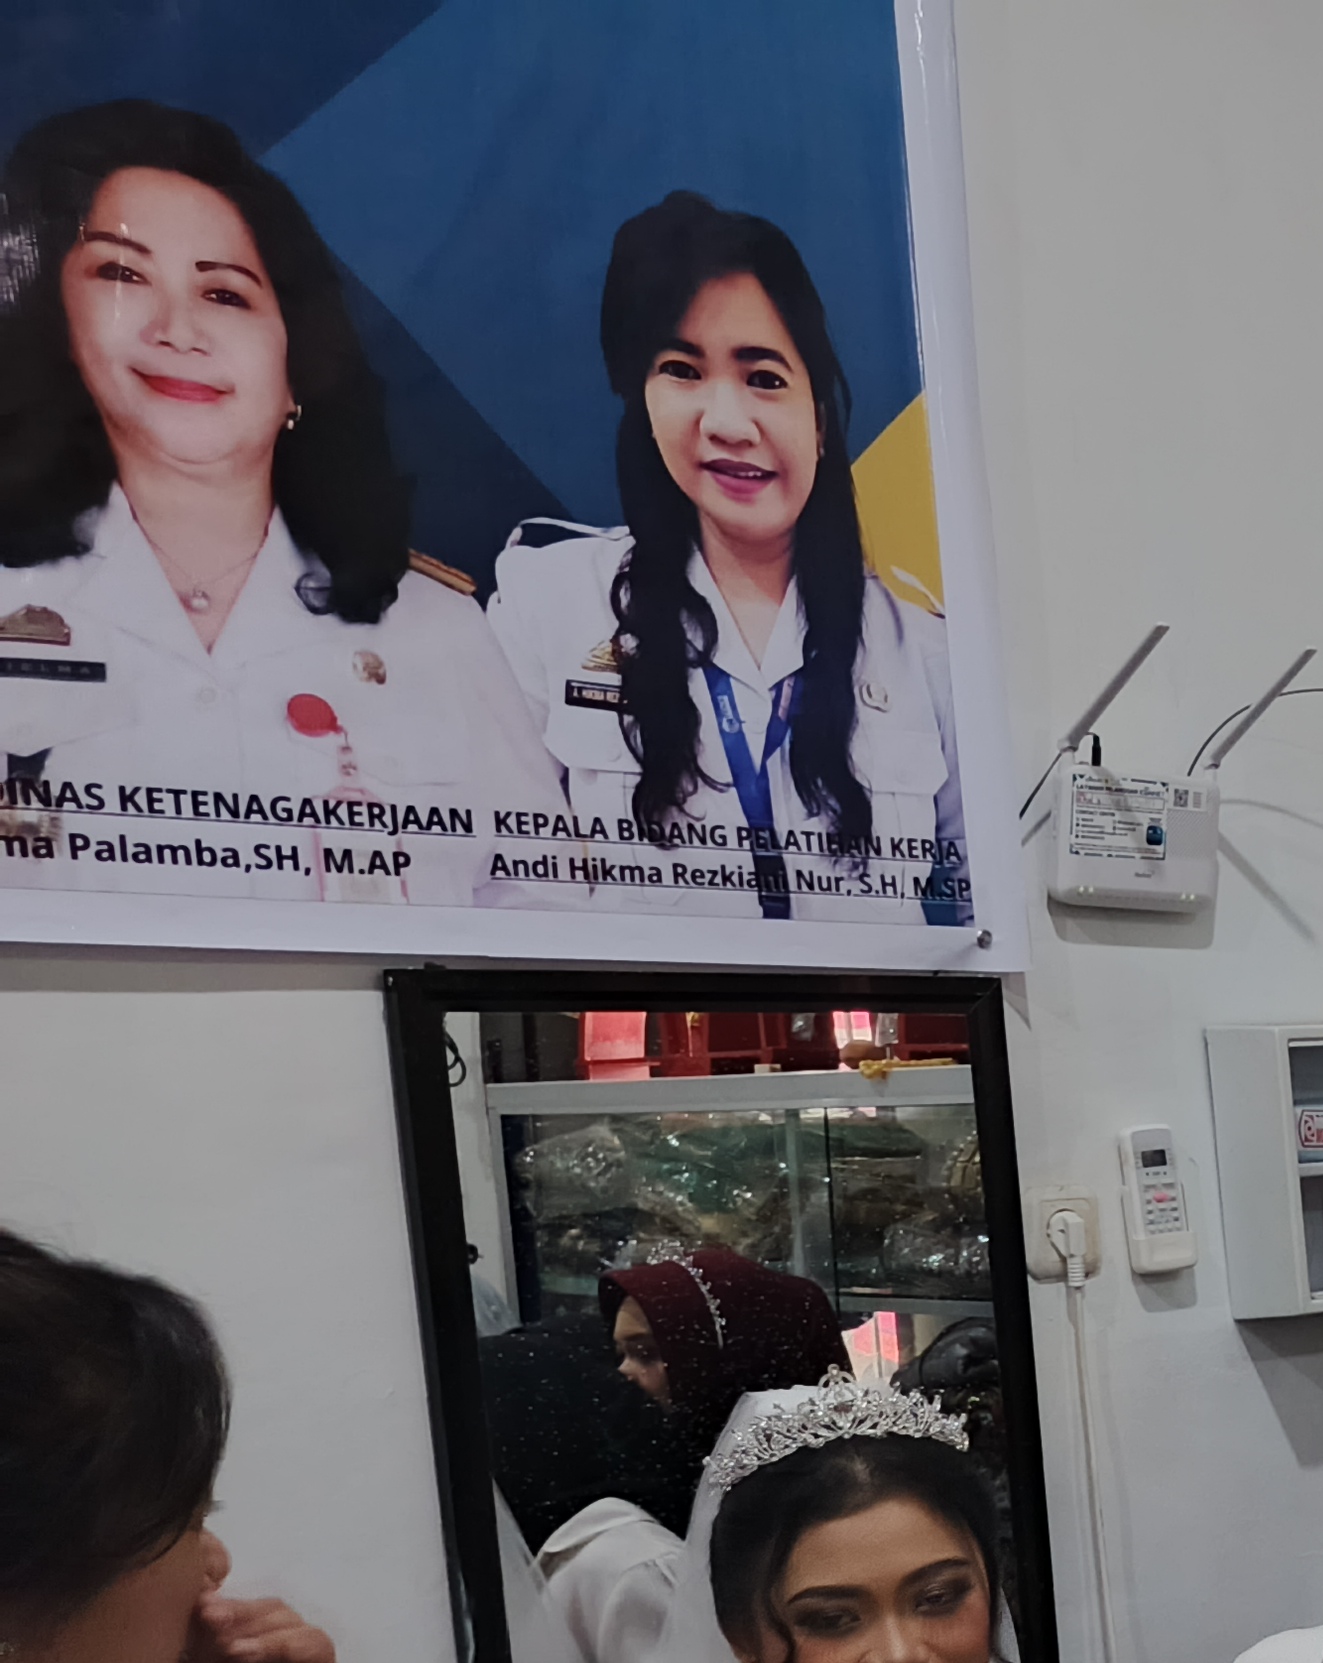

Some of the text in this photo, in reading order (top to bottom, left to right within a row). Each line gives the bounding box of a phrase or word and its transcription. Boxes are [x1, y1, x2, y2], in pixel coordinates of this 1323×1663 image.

[0, 779, 474, 836] INAS KETENAGAKERJAAN
[323, 847, 412, 877] M.AP
[493, 810, 963, 866] KEPALA BIDANG PELATIHAN KERJA
[490, 853, 559, 879] Andi
[568, 857, 663, 884] Hikma
[671, 862, 788, 890] Rezkiani
[795, 869, 852, 897] Nur,
[859, 873, 906, 899] S.H,
